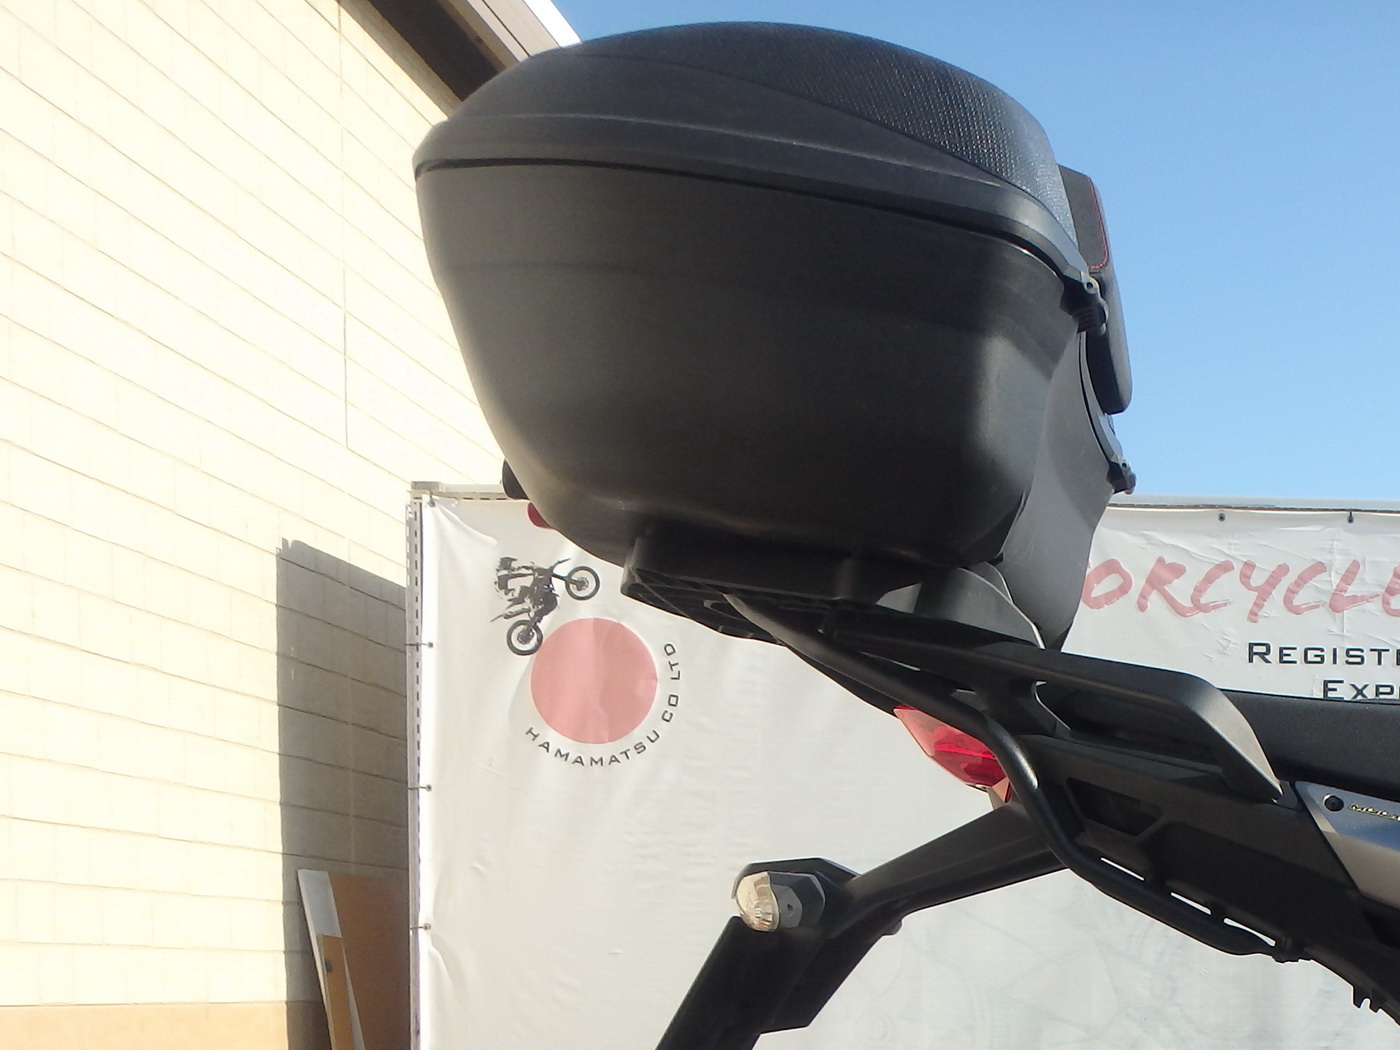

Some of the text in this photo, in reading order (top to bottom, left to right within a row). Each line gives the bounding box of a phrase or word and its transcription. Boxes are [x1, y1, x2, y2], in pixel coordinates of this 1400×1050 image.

[525, 643, 681, 767] HAMAMATSU CO LTD
